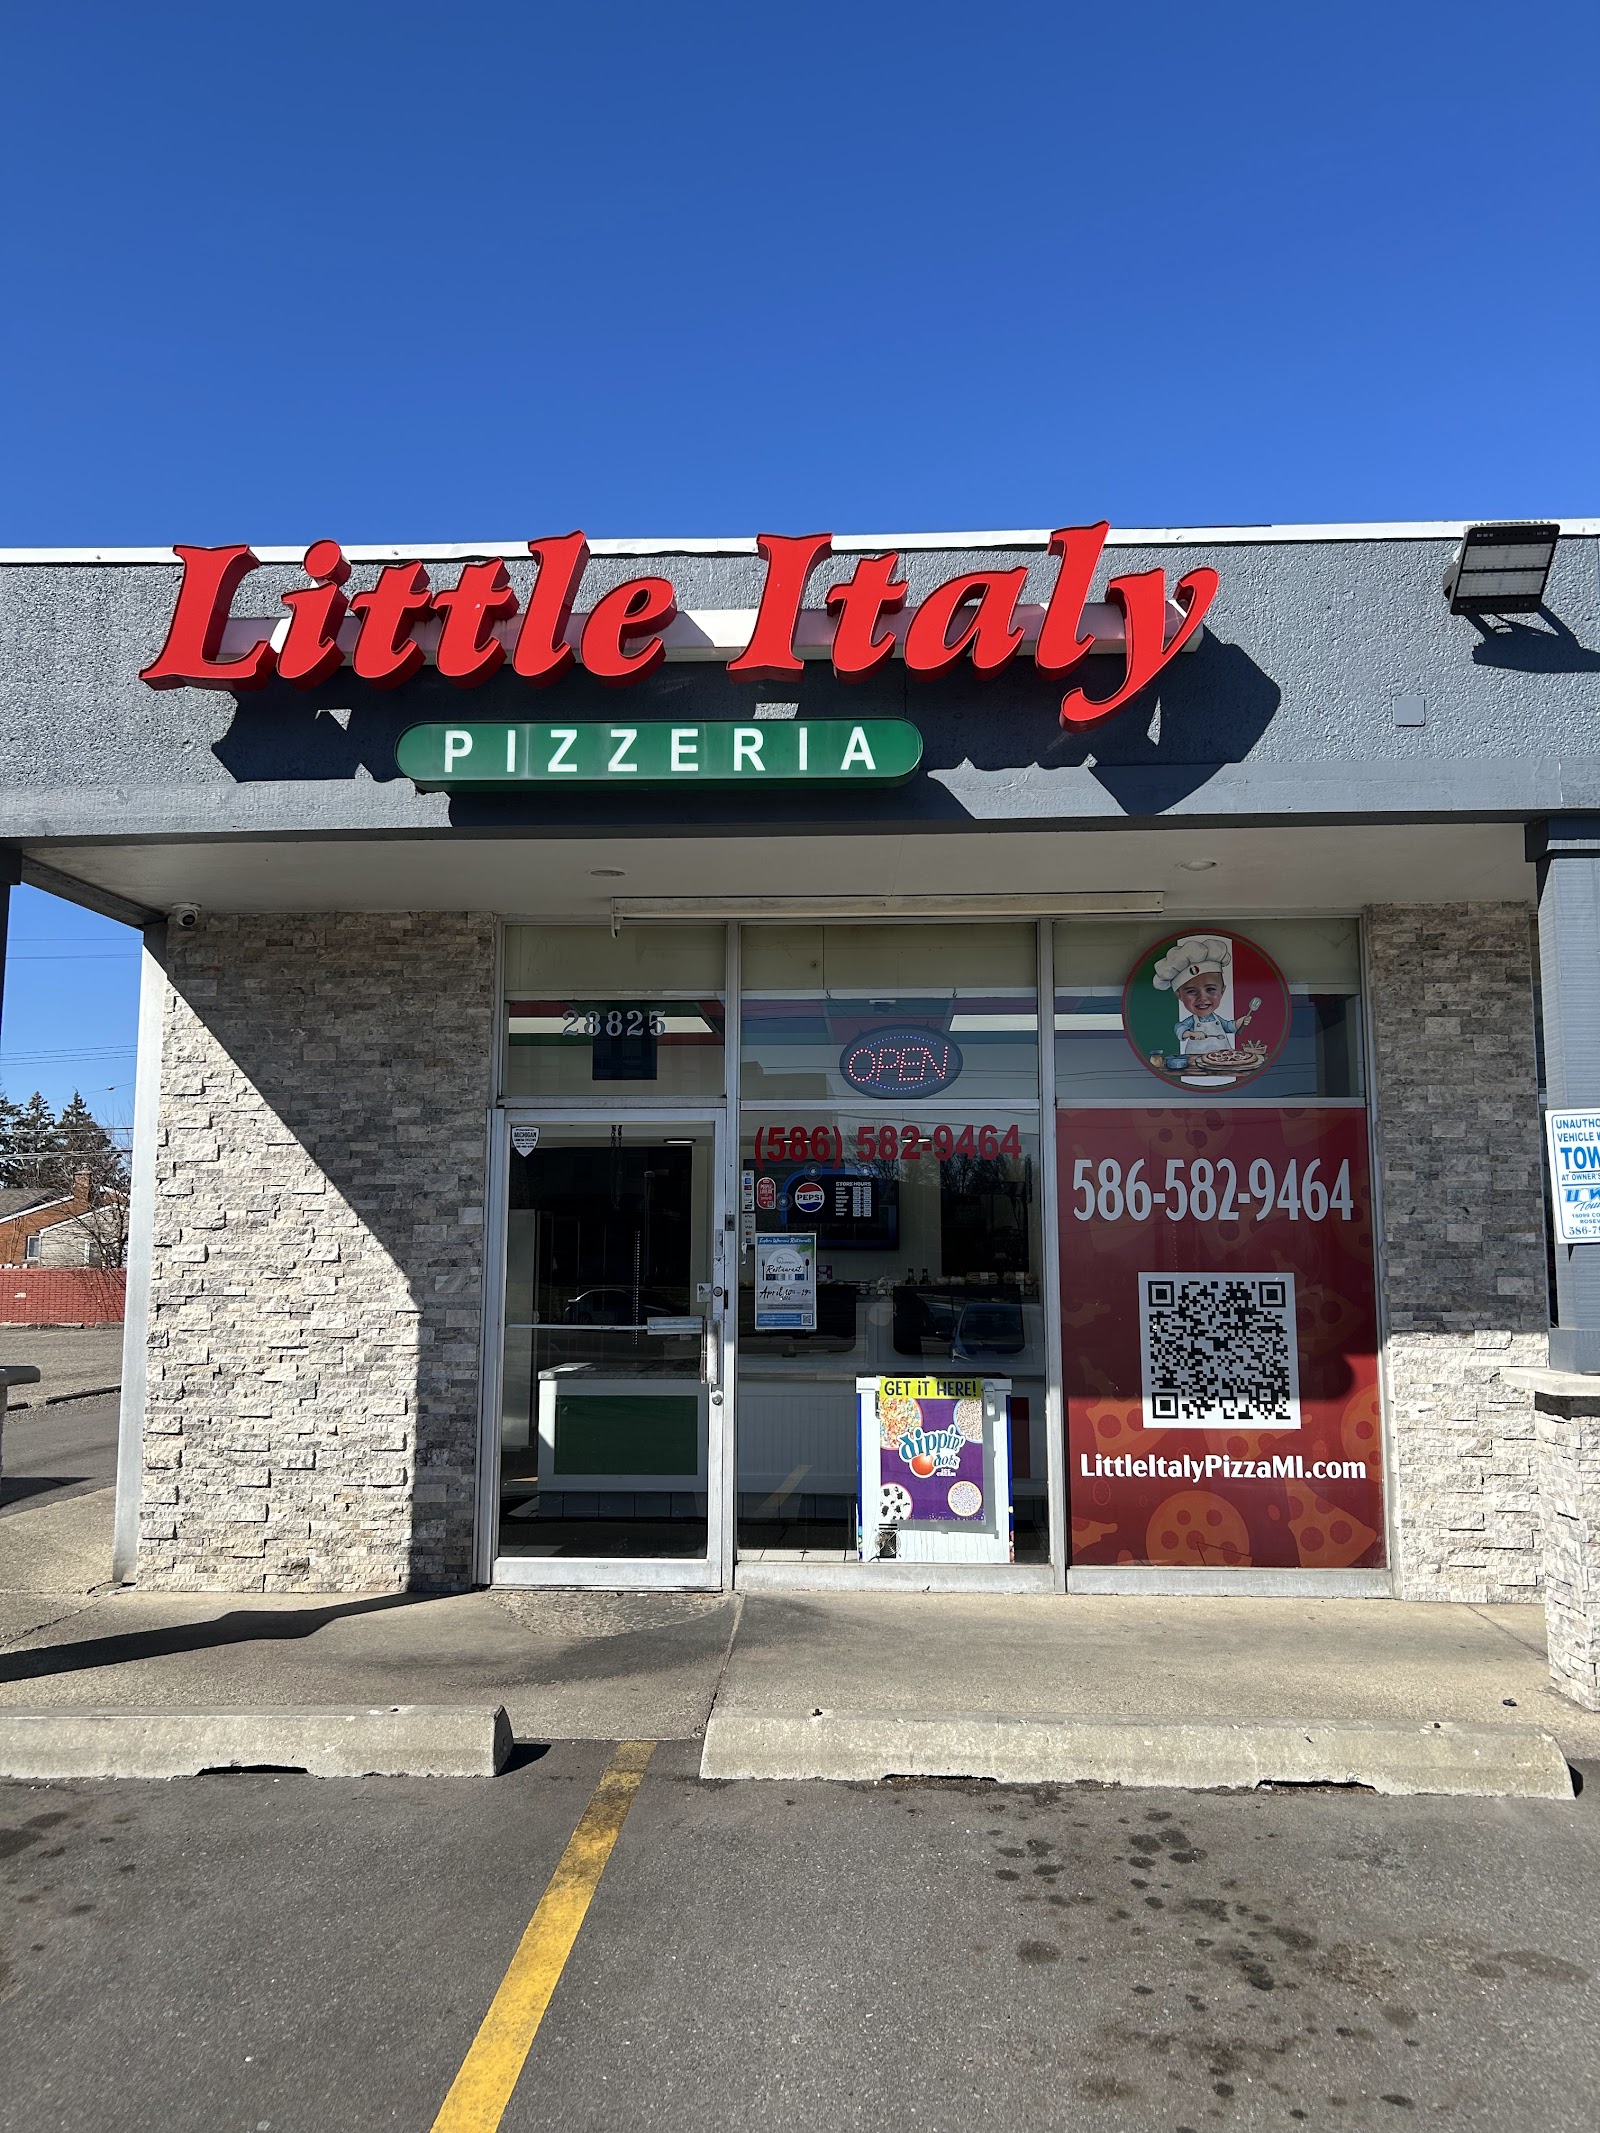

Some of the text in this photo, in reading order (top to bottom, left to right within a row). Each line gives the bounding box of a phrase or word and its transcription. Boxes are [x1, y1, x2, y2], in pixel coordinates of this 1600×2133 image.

[138, 521, 1220, 732] Little Italy
[444, 727, 876, 773] PIZZERIA
[562, 1010, 666, 1037] 28825
[848, 1045, 949, 1082] OPEN
[754, 1124, 1022, 1171] (586) 582-9464
[1557, 1132, 1594, 1142] VEHICLE
[1072, 1157, 1354, 1222] 586-582-9464
[884, 1380, 911, 1396] GET
[936, 1380, 977, 1397] HERE!
[933, 1454, 958, 1467] dots
[1080, 1453, 1367, 1483] LittleItalyPizzaMI.com
